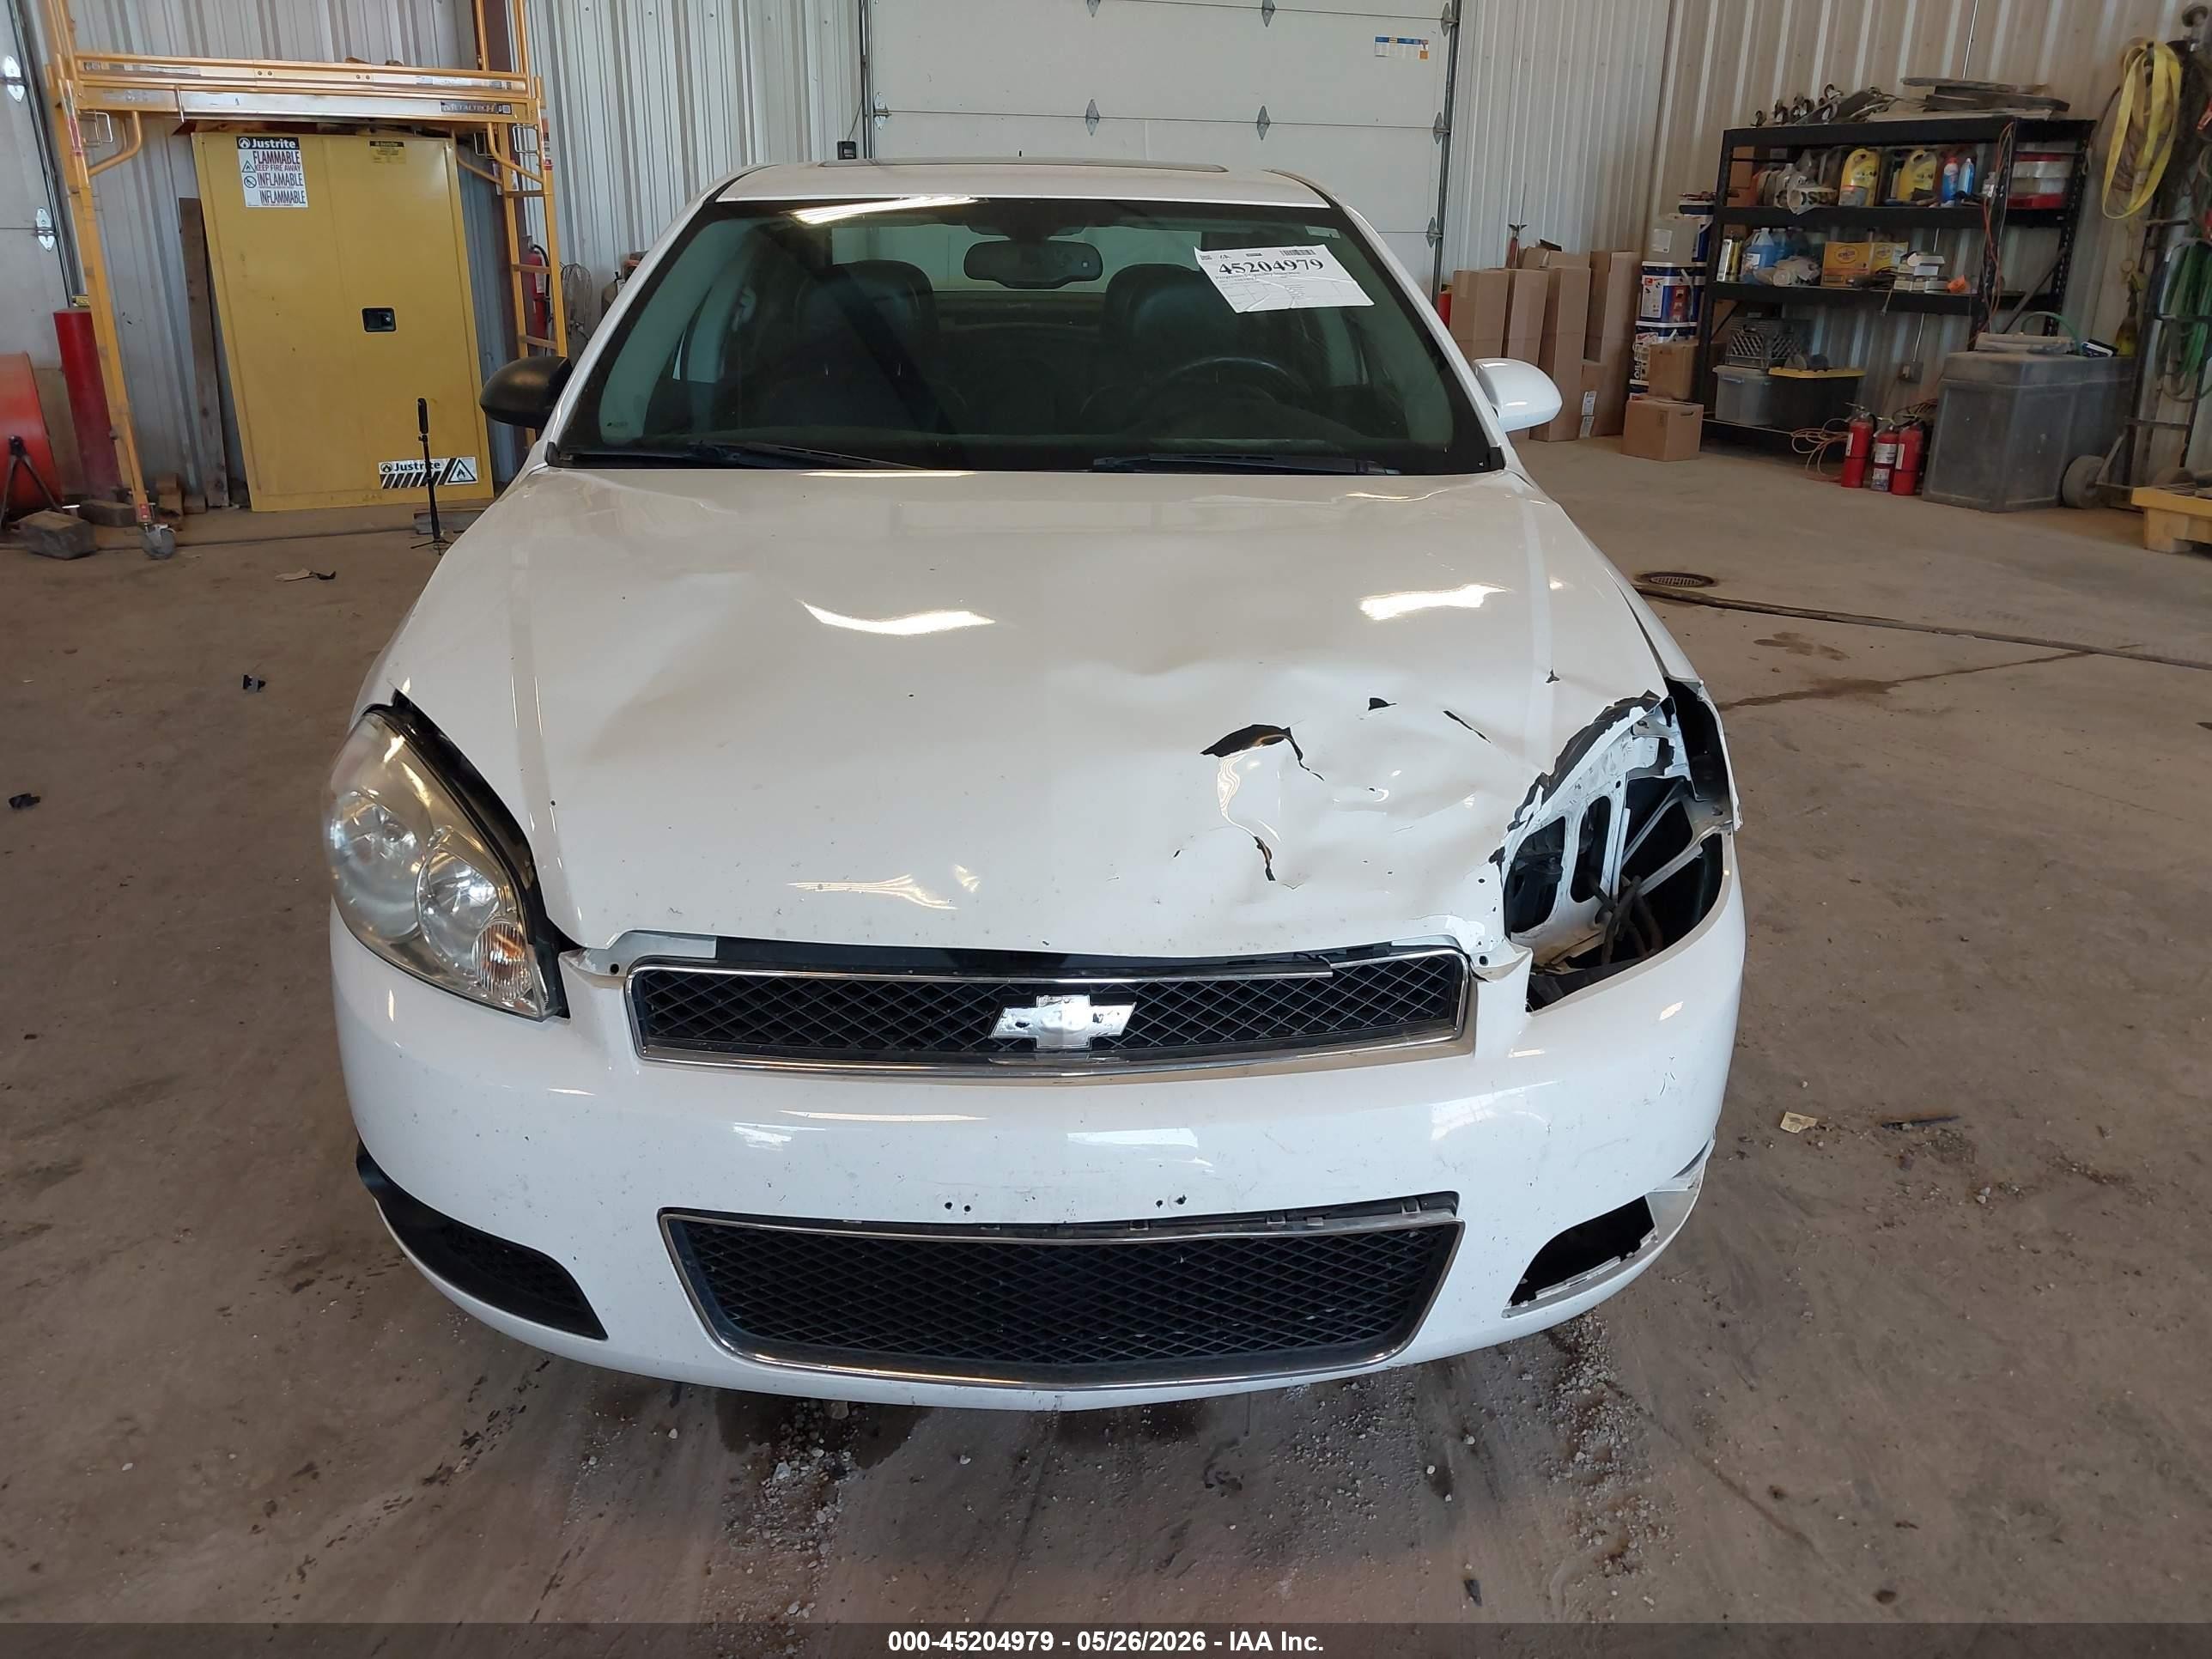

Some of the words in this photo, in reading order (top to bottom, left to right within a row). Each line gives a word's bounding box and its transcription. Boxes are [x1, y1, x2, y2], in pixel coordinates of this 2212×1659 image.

[252, 138, 296, 149] Justrite
[252, 150, 301, 165] FLAMMABLE
[257, 173, 304, 186] INFLAMABLE
[259, 190, 306, 204] INFLAMMABLE
[1218, 258, 1324, 275] 45204979
[394, 462, 441, 471] Justrte
